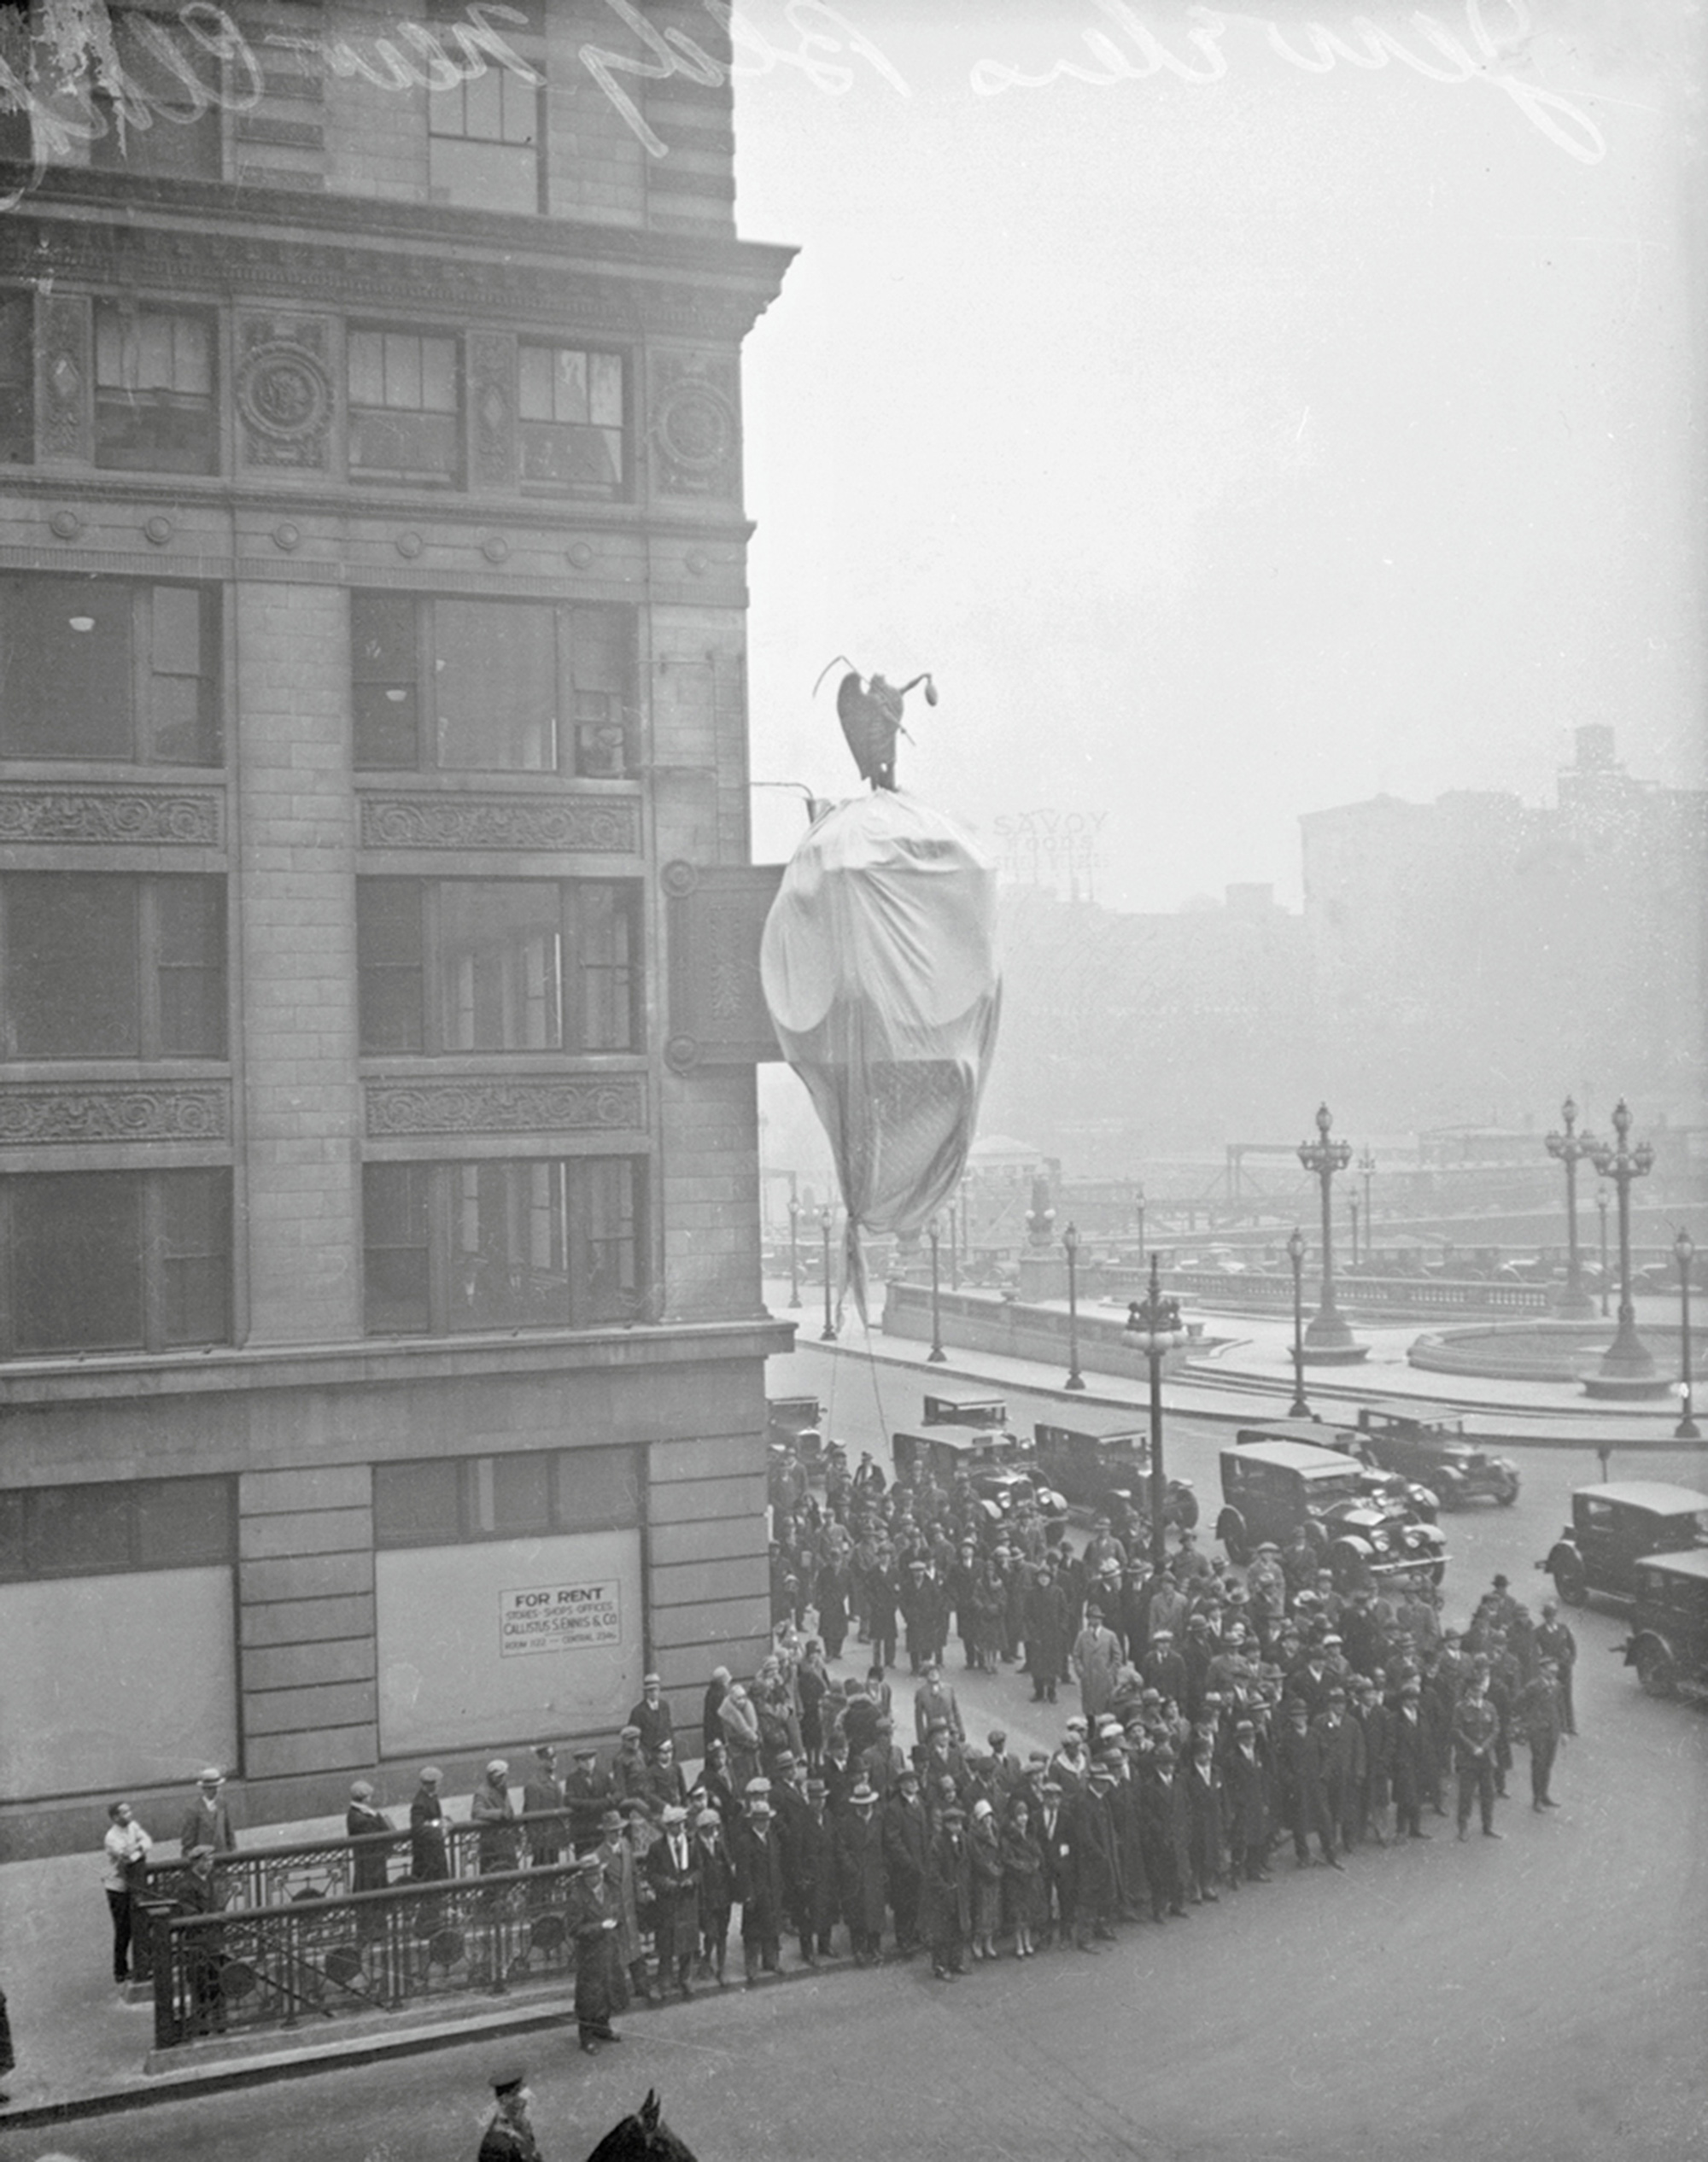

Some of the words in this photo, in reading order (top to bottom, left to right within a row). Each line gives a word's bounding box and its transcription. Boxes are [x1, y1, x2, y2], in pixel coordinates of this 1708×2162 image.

[993, 812, 1108, 835] SAVOY
[516, 1592, 550, 1607] FOR
[558, 1587, 604, 1603] RENT
[593, 1615, 601, 1627] &
